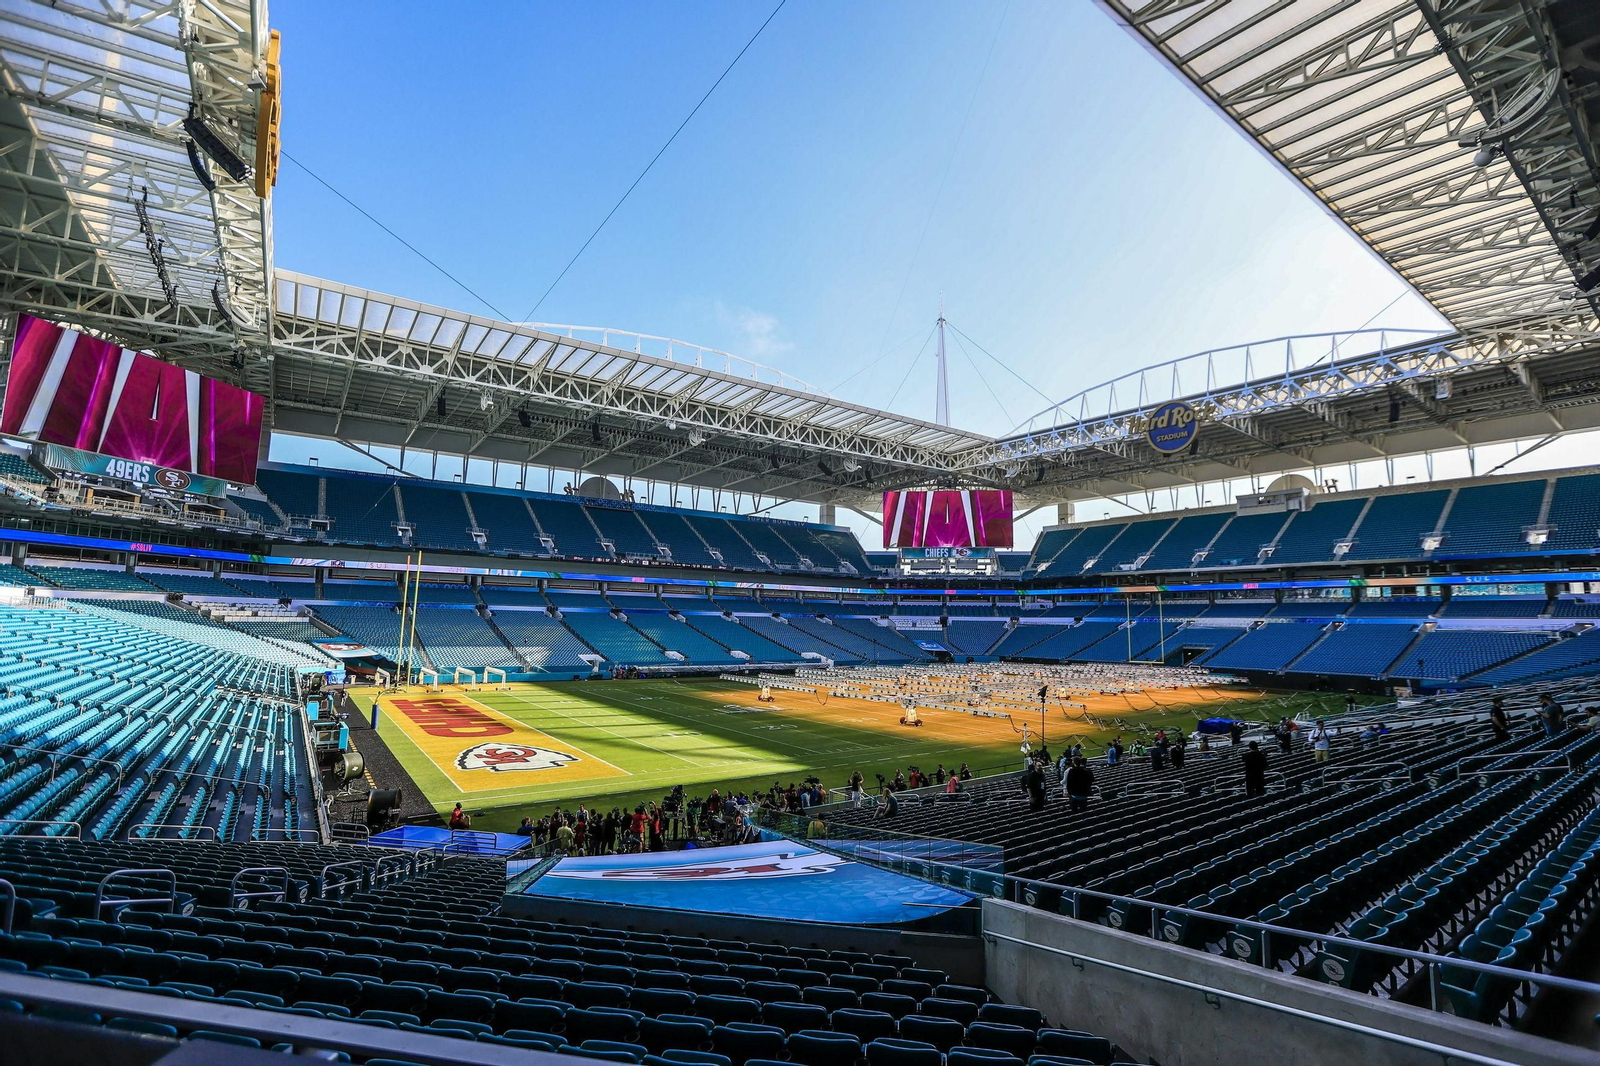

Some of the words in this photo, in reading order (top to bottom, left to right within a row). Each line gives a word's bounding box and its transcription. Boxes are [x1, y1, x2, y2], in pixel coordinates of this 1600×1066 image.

[1128, 409, 1170, 434] Hard
[1172, 402, 1216, 428] Rock
[1156, 431, 1188, 443] STADIUM
[105, 458, 151, 483] 49ERS
[924, 548, 949, 558] CHIEFS
[389, 698, 515, 738] CHIEFS
